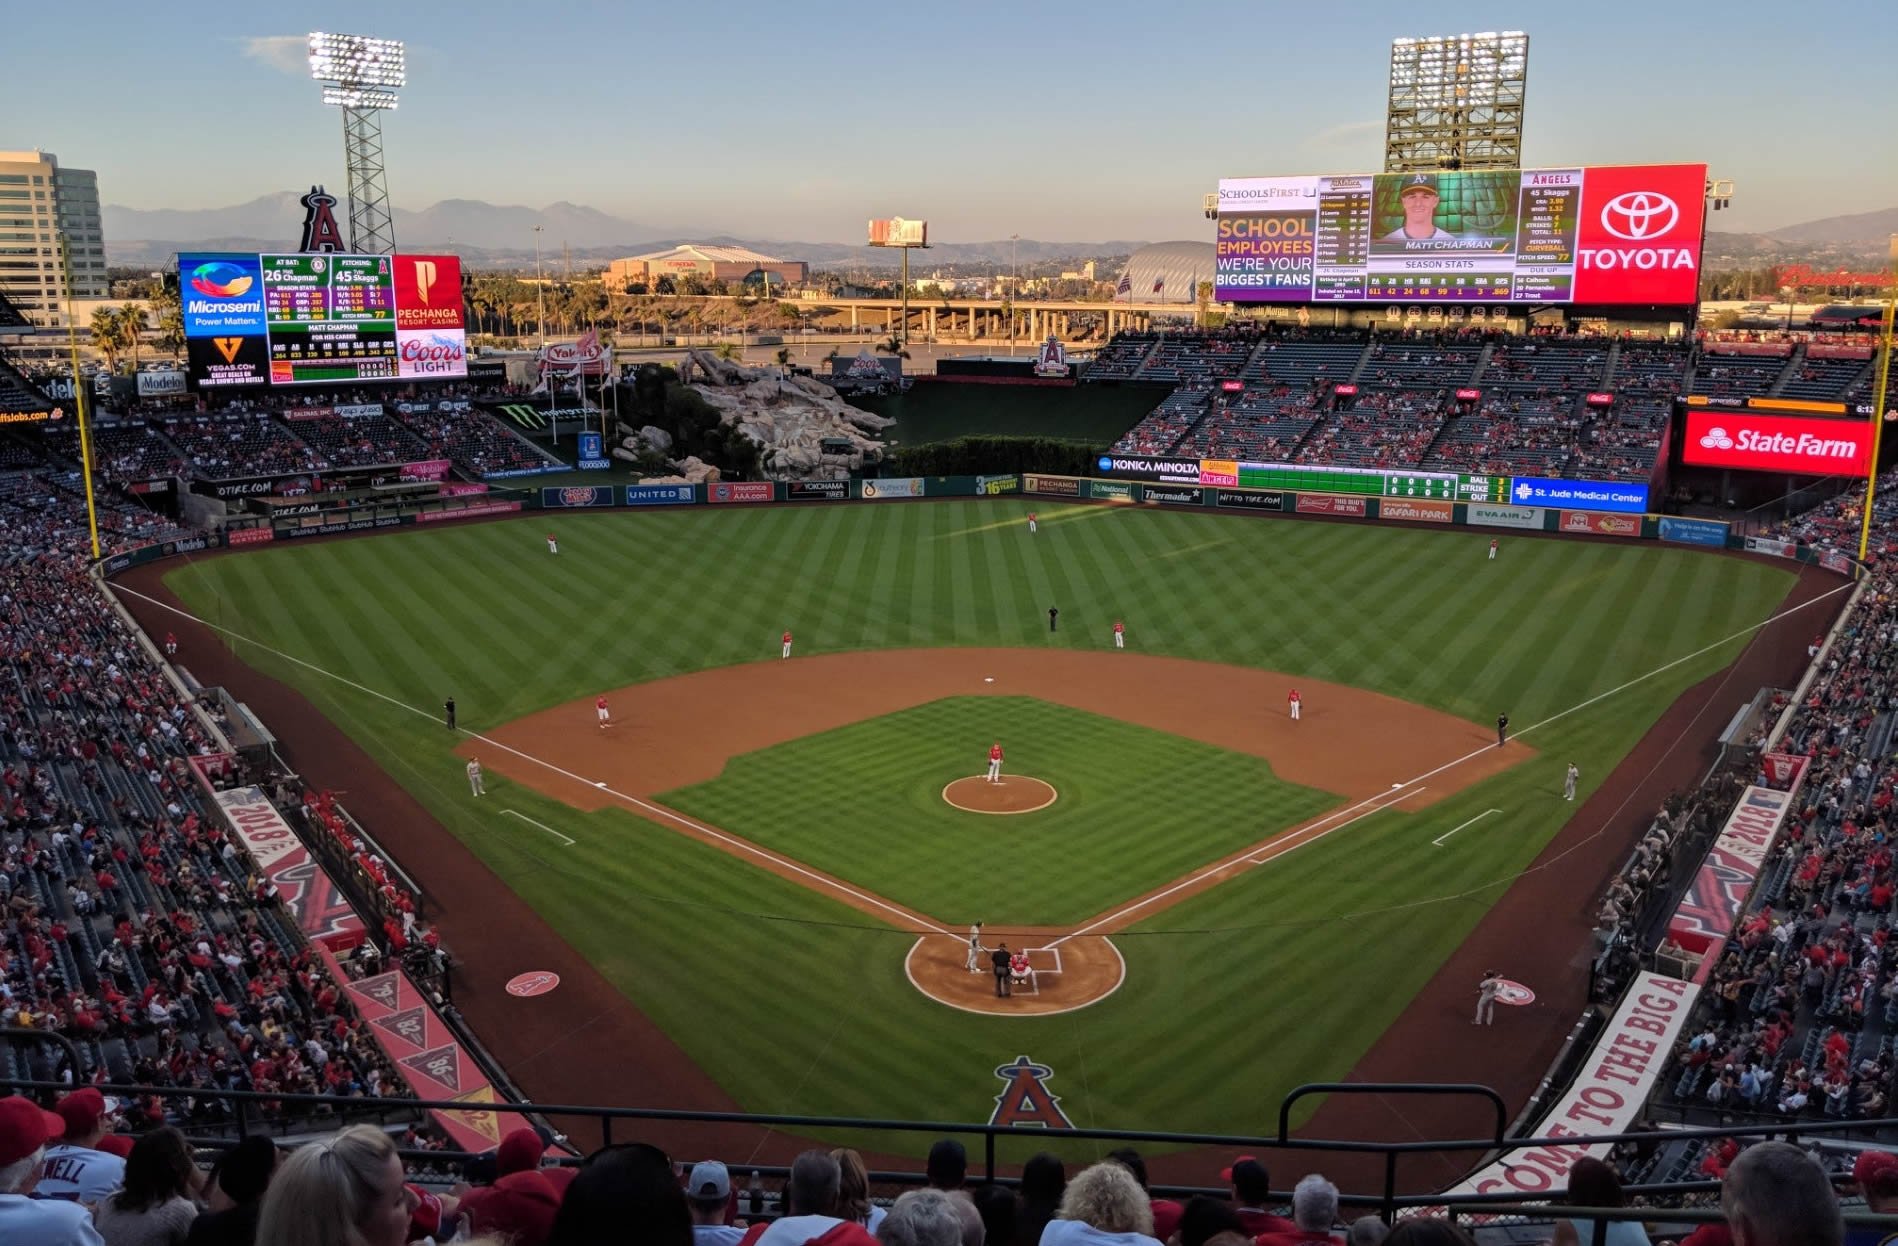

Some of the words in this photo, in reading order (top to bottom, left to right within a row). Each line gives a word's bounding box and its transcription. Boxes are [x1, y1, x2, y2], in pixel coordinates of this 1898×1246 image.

[1532, 174, 1571, 185] ANGELS
[1543, 190, 1570, 198] Skaggs
[1218, 218, 1313, 239] SCHOOL
[1217, 240, 1313, 256] EMPLOYEES
[1432, 239, 1493, 250] CHAPMAN
[1525, 245, 1567, 253] CURVEBALL
[1558, 253, 1570, 261] 77
[1579, 248, 1695, 270] TOYOTA
[1217, 256, 1264, 271] WE'RE
[1268, 256, 1312, 271] YOUR
[1405, 260, 1442, 269] SEASON
[1445, 260, 1474, 269] STATS
[265, 270, 282, 281] 26
[283, 274, 318, 284] Chapman
[336, 271, 352, 281] 45
[353, 275, 379, 284] Skaggs
[1216, 273, 1272, 287] BIGGEST
[1275, 273, 1311, 286] FANS
[1369, 287, 1381, 296] 611
[1387, 287, 1397, 296] 42
[1403, 287, 1413, 296] 24
[1437, 287, 1448, 296] 99
[375, 311, 385, 320] 77
[398, 308, 458, 320] PECHANGA
[195, 317, 218, 327] Power
[400, 339, 462, 363] Coors
[206, 363, 256, 372] VEGAS.COM
[413, 361, 453, 373] LIGHT
[142, 376, 182, 391] Modelo
[413, 403, 430, 411] WEST
[452, 401, 469, 410] WEST
[1708, 397, 1742, 405] generation
[1856, 405, 1875, 414] 6:13
[1112, 459, 1153, 471] KONICA
[1153, 461, 1200, 474] MINOLTA
[1039, 480, 1078, 490] PECHANGA
[1470, 476, 1489, 485] BALL
[732, 484, 767, 492] Insurance
[804, 482, 844, 491] YOKOHAMA
[1101, 484, 1129, 494] National
[1460, 483, 1489, 494] STRIKE
[628, 489, 676, 500] UNITED
[733, 493, 768, 501] AAA.com
[826, 490, 844, 498] TIRES
[1144, 489, 1192, 503] Thermador
[1471, 492, 1488, 502] OUT
[1535, 488, 1548, 497] St.
[1550, 489, 1571, 499] Jude
[1573, 489, 1610, 501] Medical
[1612, 492, 1644, 504] Center
[1334, 498, 1347, 506] THIS
[1383, 507, 1420, 519] SAFARI
[1420, 510, 1448, 521] PARK
[1475, 510, 1504, 519] EVA
[1505, 511, 1522, 519] AIR
[290, 527, 317, 537] StubHub
[319, 524, 346, 534] StubHub
[348, 521, 373, 532] StubHub
[375, 517, 401, 528] StubHub
[229, 803, 282, 843] 2018
[1729, 805, 1779, 846] 2018
[1648, 976, 1688, 997] A
[1624, 993, 1680, 1037] BIG
[1594, 1032, 1657, 1087] THE
[1566, 1087, 1625, 1127] TO
